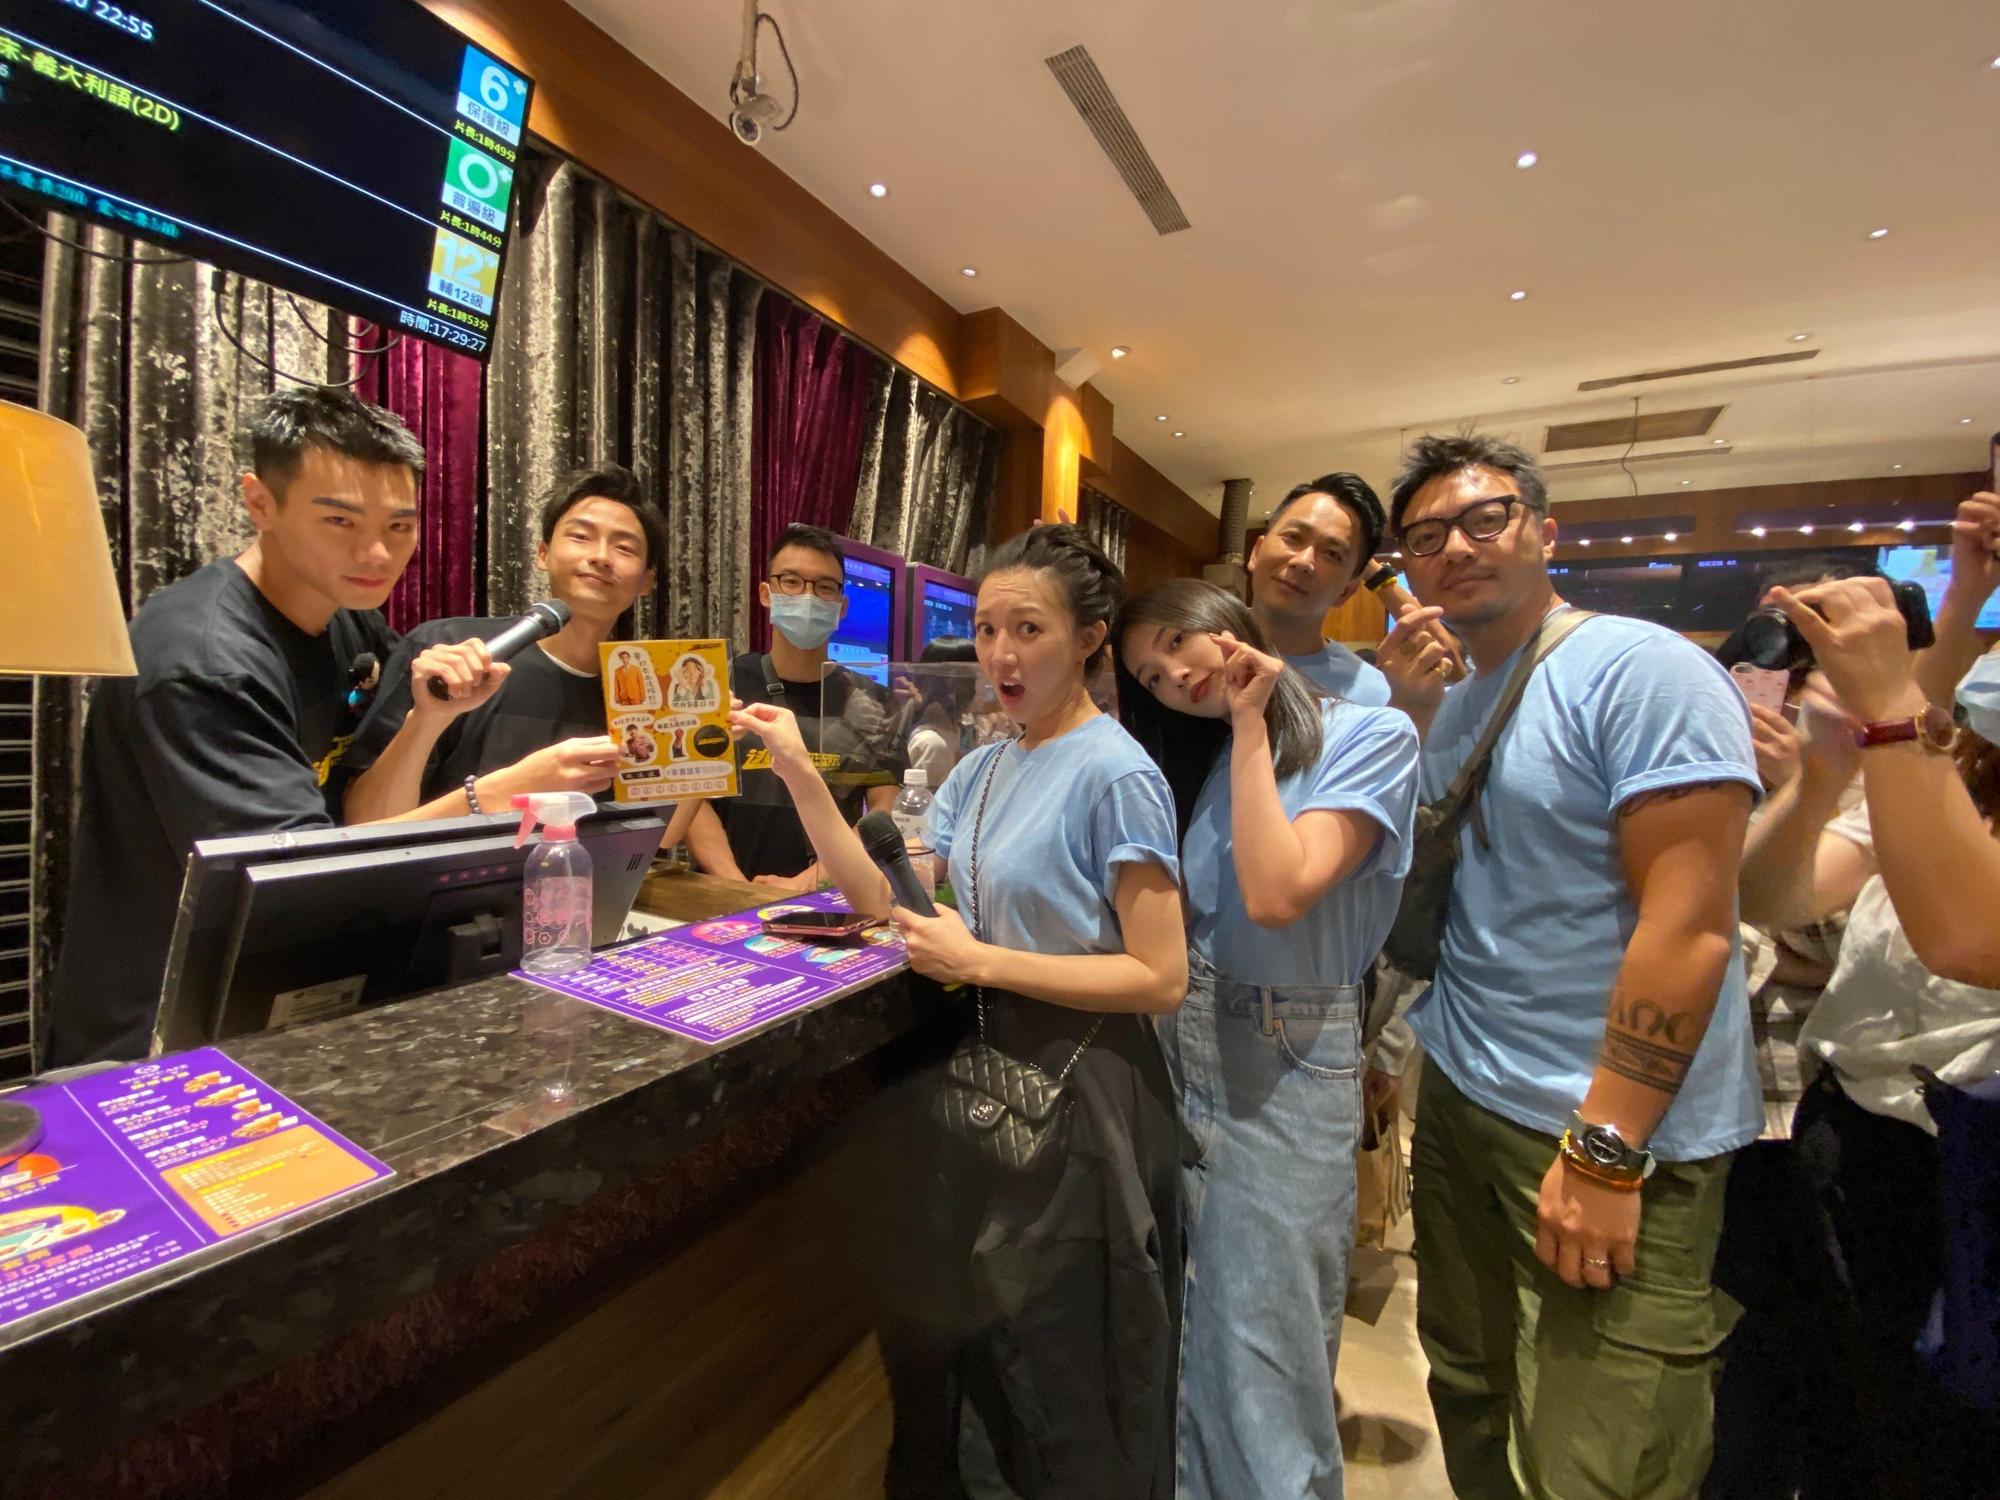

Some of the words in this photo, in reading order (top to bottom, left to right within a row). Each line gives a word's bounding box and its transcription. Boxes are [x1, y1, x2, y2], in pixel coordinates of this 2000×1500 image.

[95, 1, 153, 40] 22:55
[467, 101, 510, 138] 保護級
[453, 191, 496, 224] 普遍級
[439, 279, 484, 308] 輔12級
[400, 310, 487, 353] 時間:17:29:27
